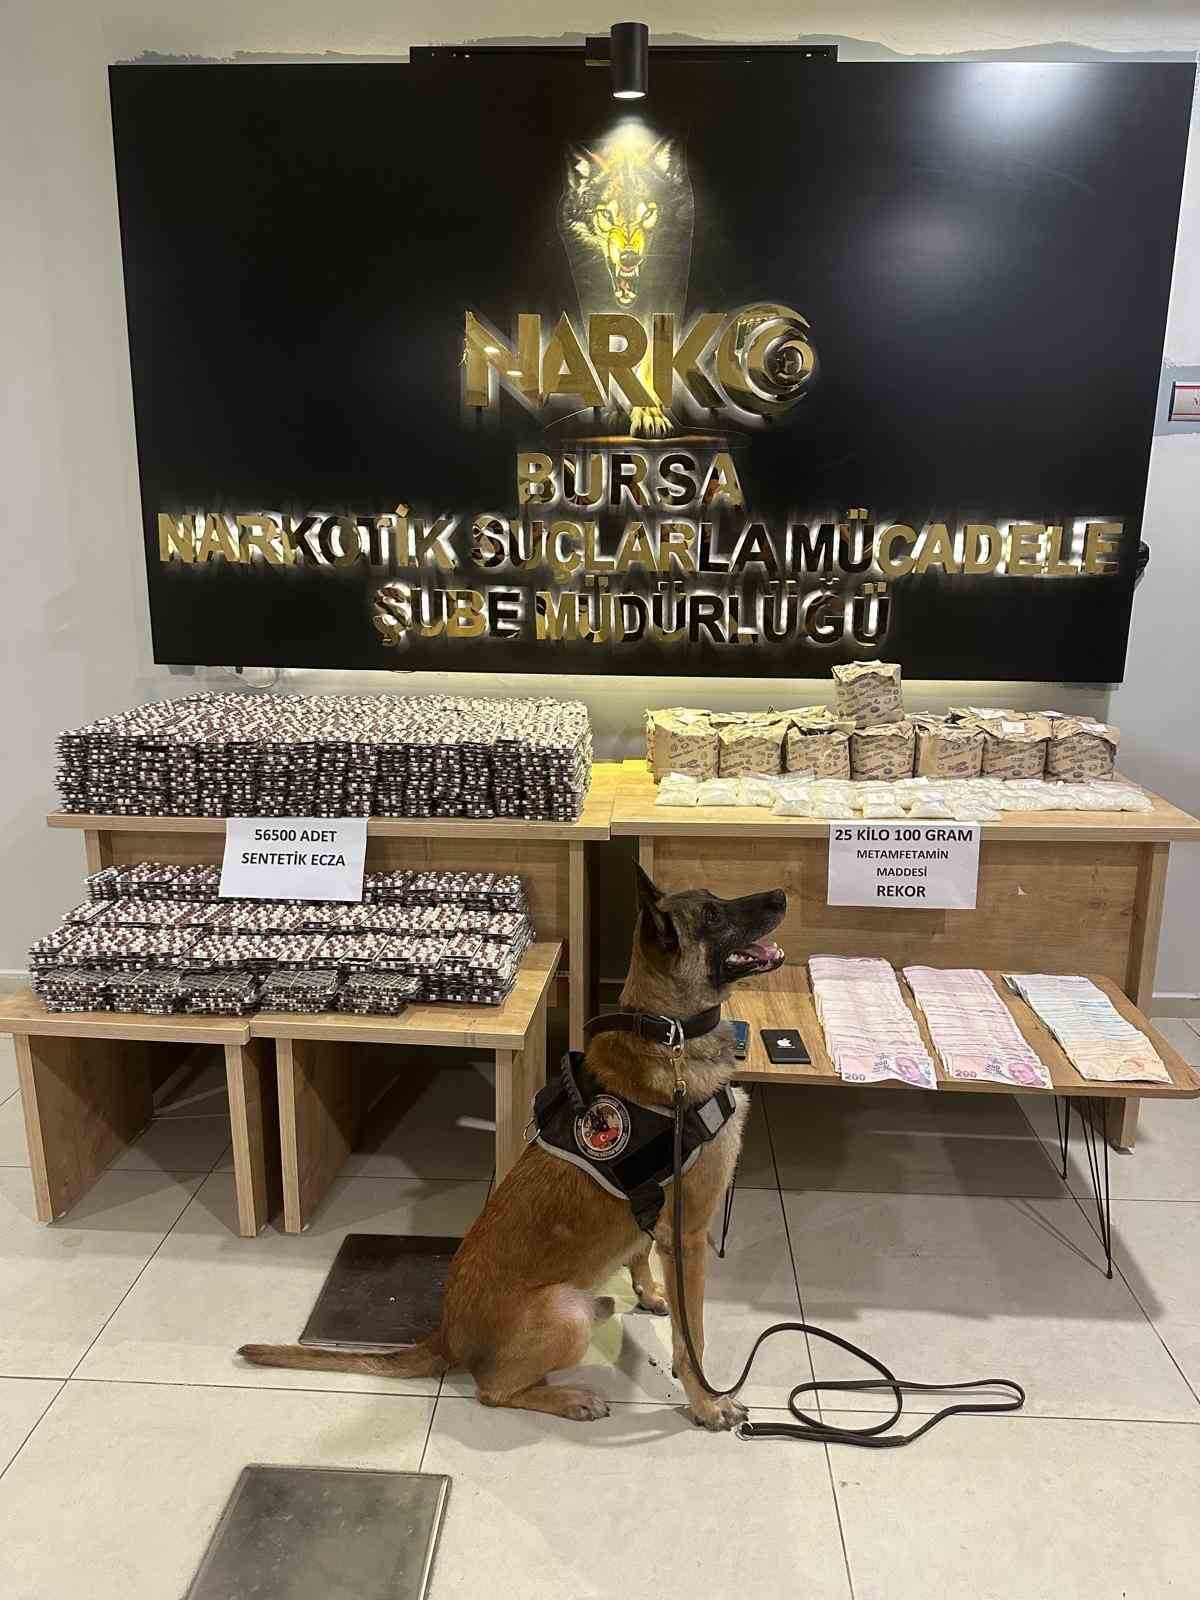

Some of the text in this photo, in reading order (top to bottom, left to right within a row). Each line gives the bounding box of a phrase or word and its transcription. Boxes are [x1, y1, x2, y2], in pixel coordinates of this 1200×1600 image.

[462, 303, 816, 417] NARKO
[517, 452, 745, 506] BURSA
[158, 503, 1123, 585] NARKOTİK SUÇLARLA MÜCADELE
[373, 575, 892, 647] ŞUBE MÜDÜRLÜĞÜ
[254, 829, 337, 842] 56500 ADET
[835, 826, 973, 842] 25 KİLO 100 GRAM
[241, 850, 346, 866] SENTETİK ECZA
[856, 848, 949, 860] METAMFETAMİN
[876, 866, 928, 877] MADDESİ
[876, 885, 926, 897] REKOR
